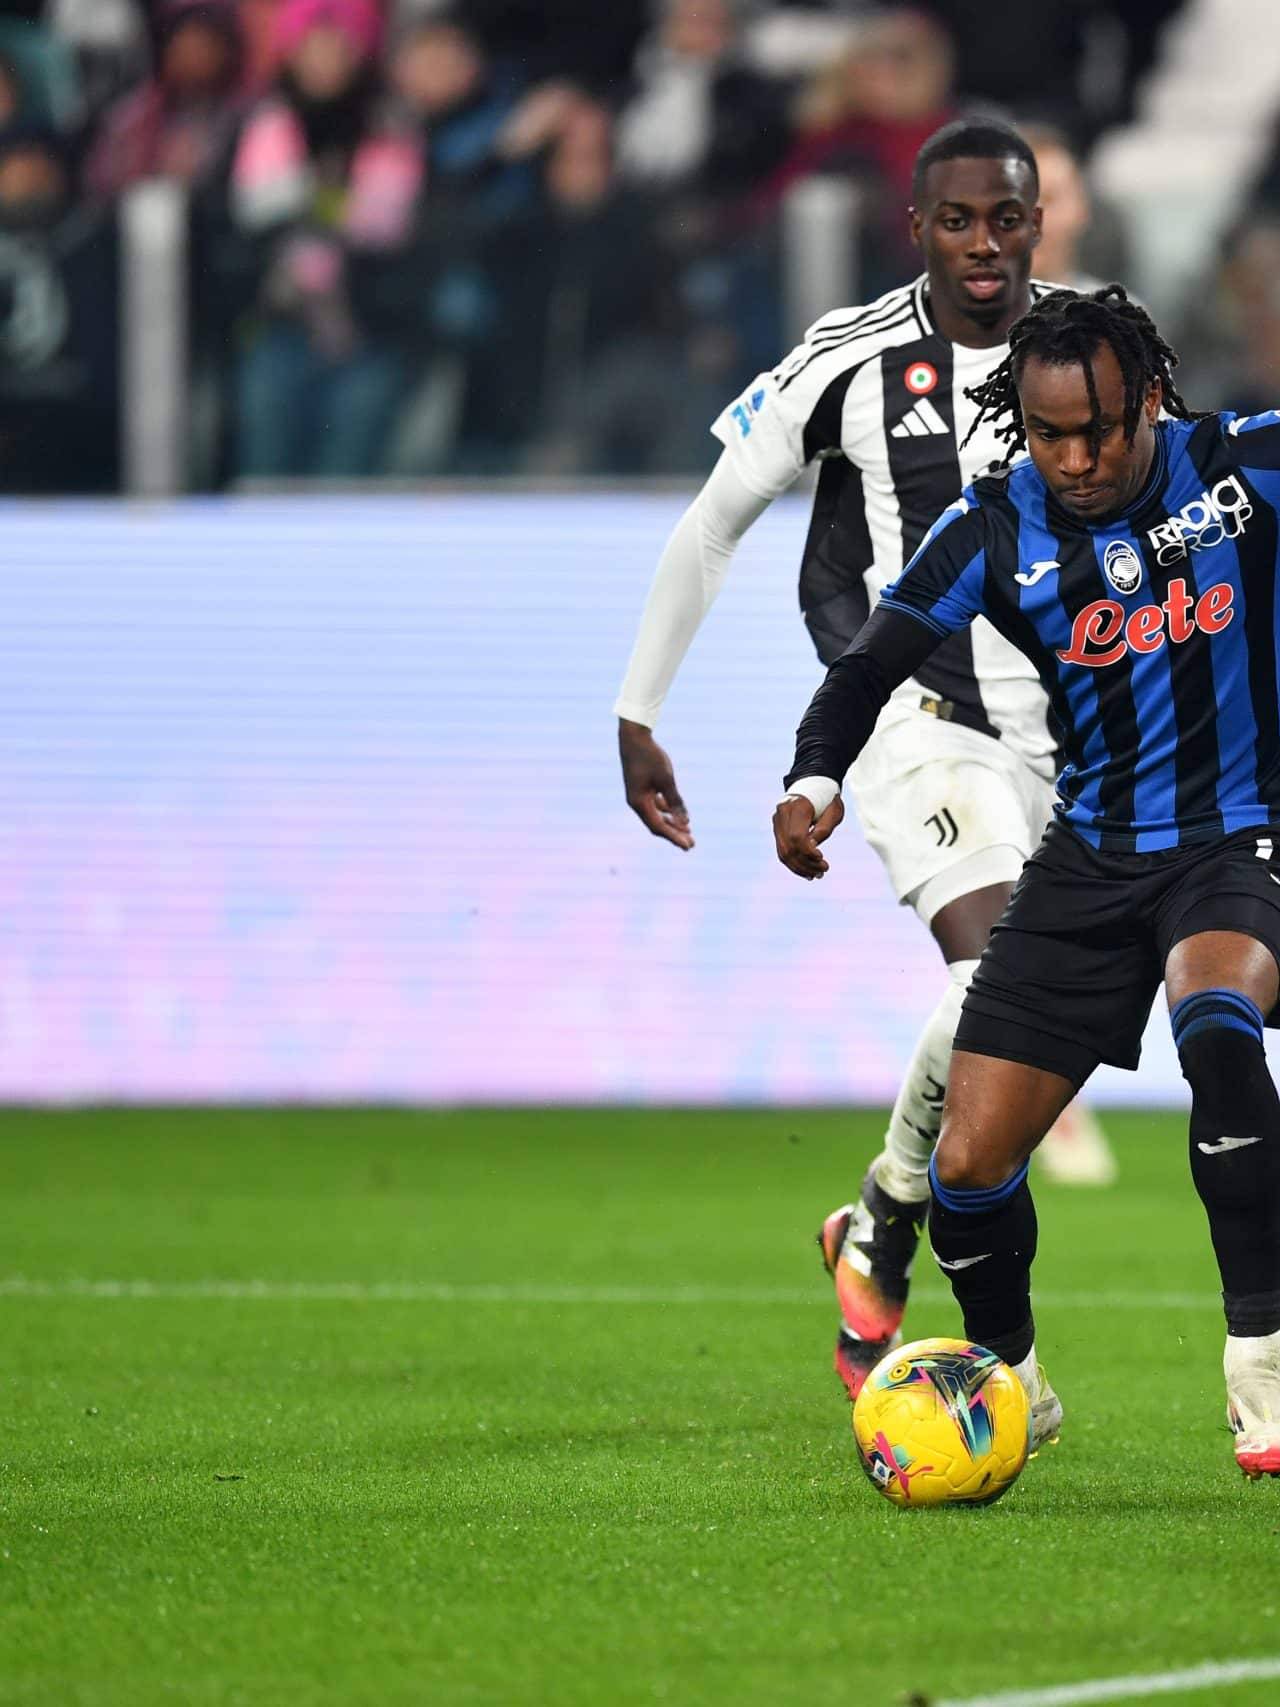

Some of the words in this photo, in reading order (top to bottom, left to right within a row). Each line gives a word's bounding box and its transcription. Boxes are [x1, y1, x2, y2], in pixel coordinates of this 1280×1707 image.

[1146, 474, 1249, 550] RADICI
[1156, 503, 1253, 567] GROUP
[1056, 577, 1235, 667] Lete
